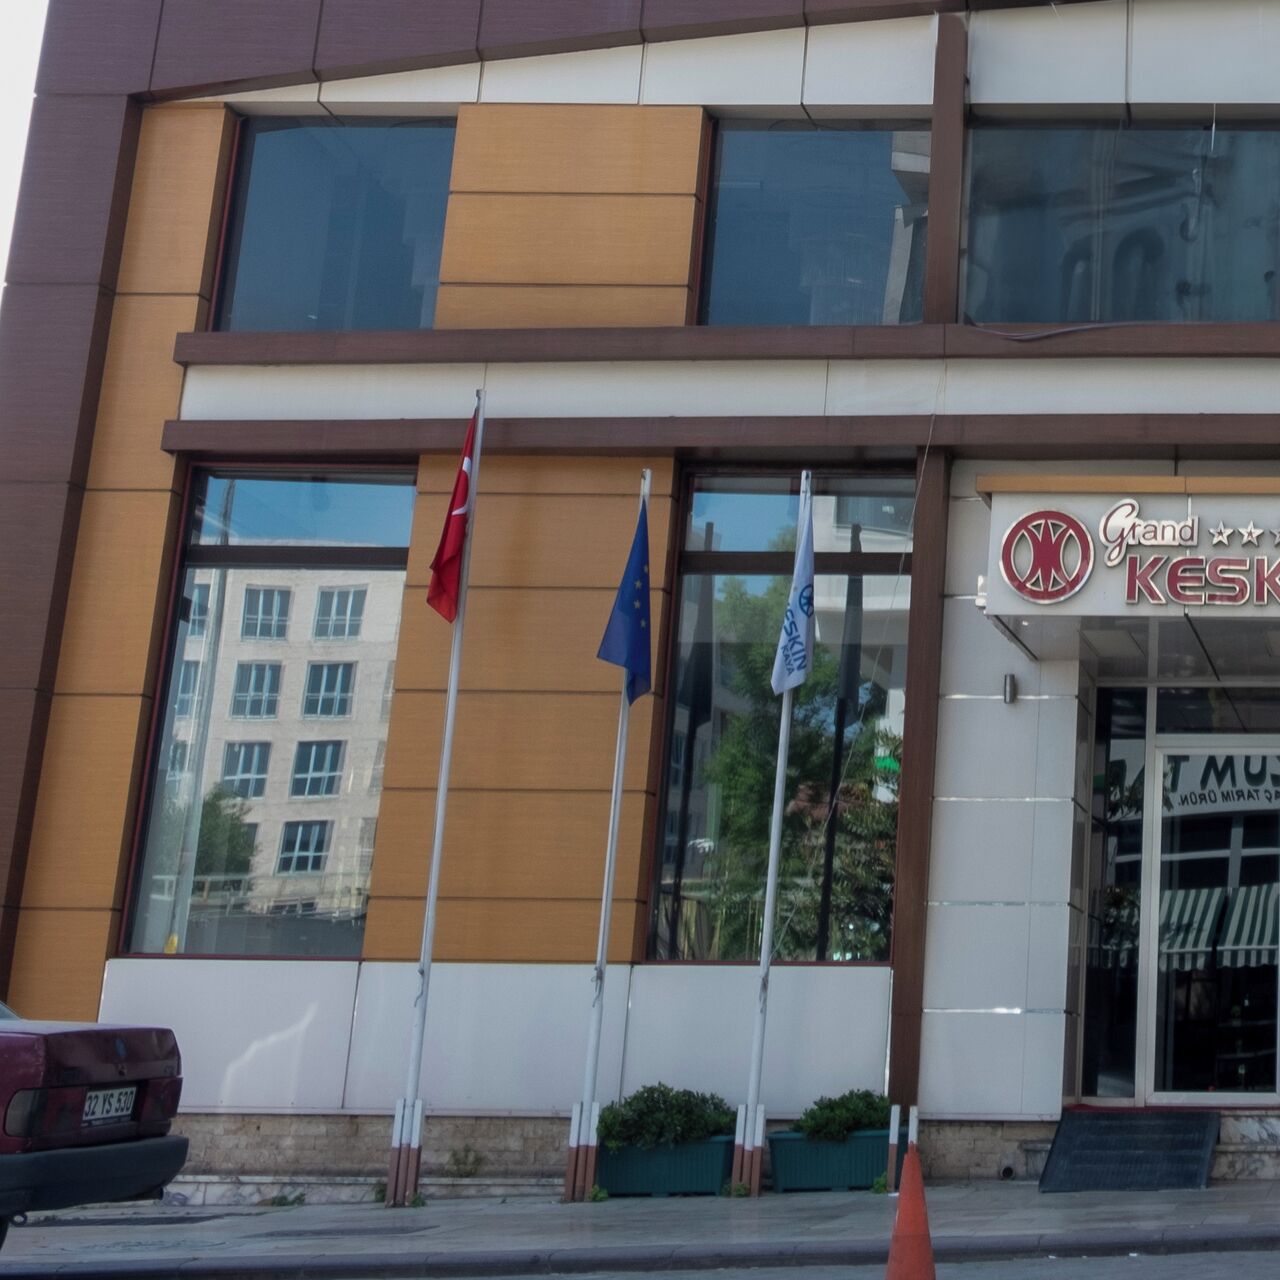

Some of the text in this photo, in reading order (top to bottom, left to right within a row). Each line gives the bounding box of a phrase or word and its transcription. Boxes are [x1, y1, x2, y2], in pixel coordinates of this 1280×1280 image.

[1100, 499, 1198, 566] Grand
[85, 1090, 133, 1117] 32 YS 530
